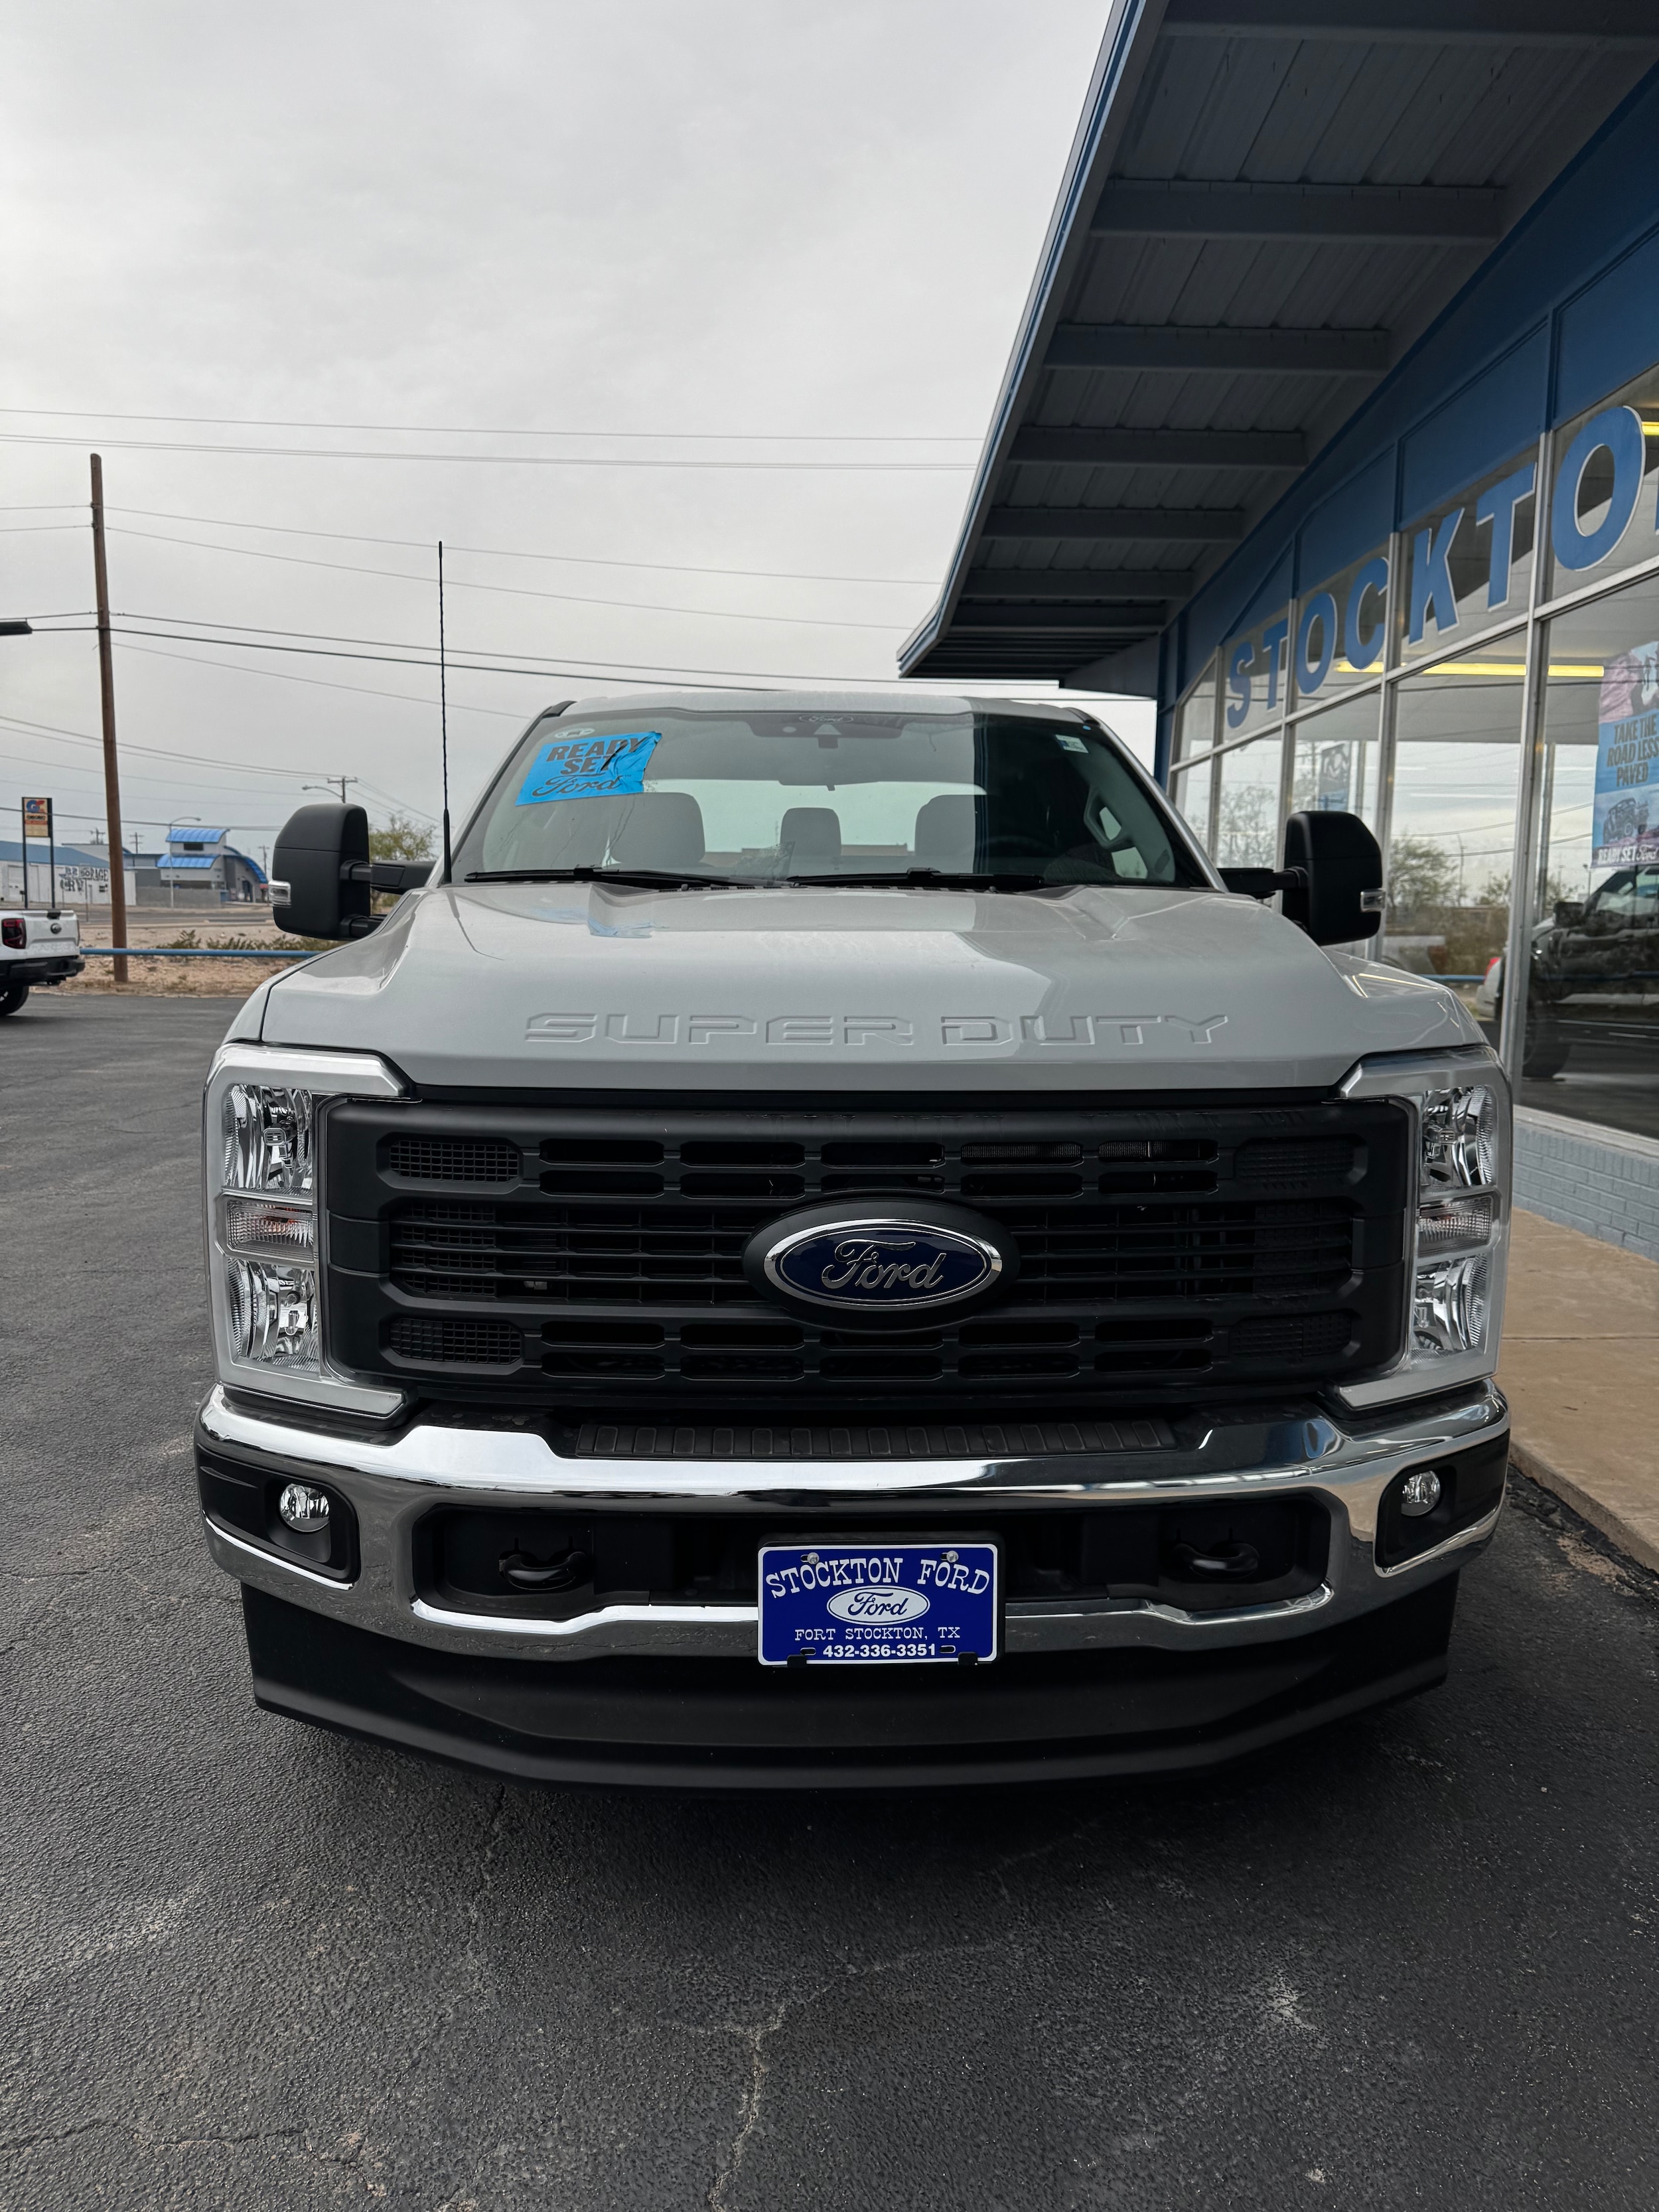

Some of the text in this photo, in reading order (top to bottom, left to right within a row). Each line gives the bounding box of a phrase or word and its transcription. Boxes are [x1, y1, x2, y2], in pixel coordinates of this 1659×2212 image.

[1226, 405, 1659, 729] STOCKTO
[1614, 713, 1657, 744] TAKE THE
[546, 737, 650, 762] READY
[1607, 743, 1636, 767] ROAD
[560, 755, 616, 775] SET
[1616, 761, 1649, 787] PAVED
[532, 772, 622, 796] Ford
[1621, 844, 1638, 862] SET
[525, 1012, 1229, 1046] SUPER DUTY
[822, 1238, 947, 1289] Ford
[765, 1557, 991, 1599] STOCKTON FORD
[847, 1591, 909, 1616] Ford
[794, 1626, 960, 1641] FORT STOCKTON, TX
[823, 1643, 936, 1658] 432-336-3351
